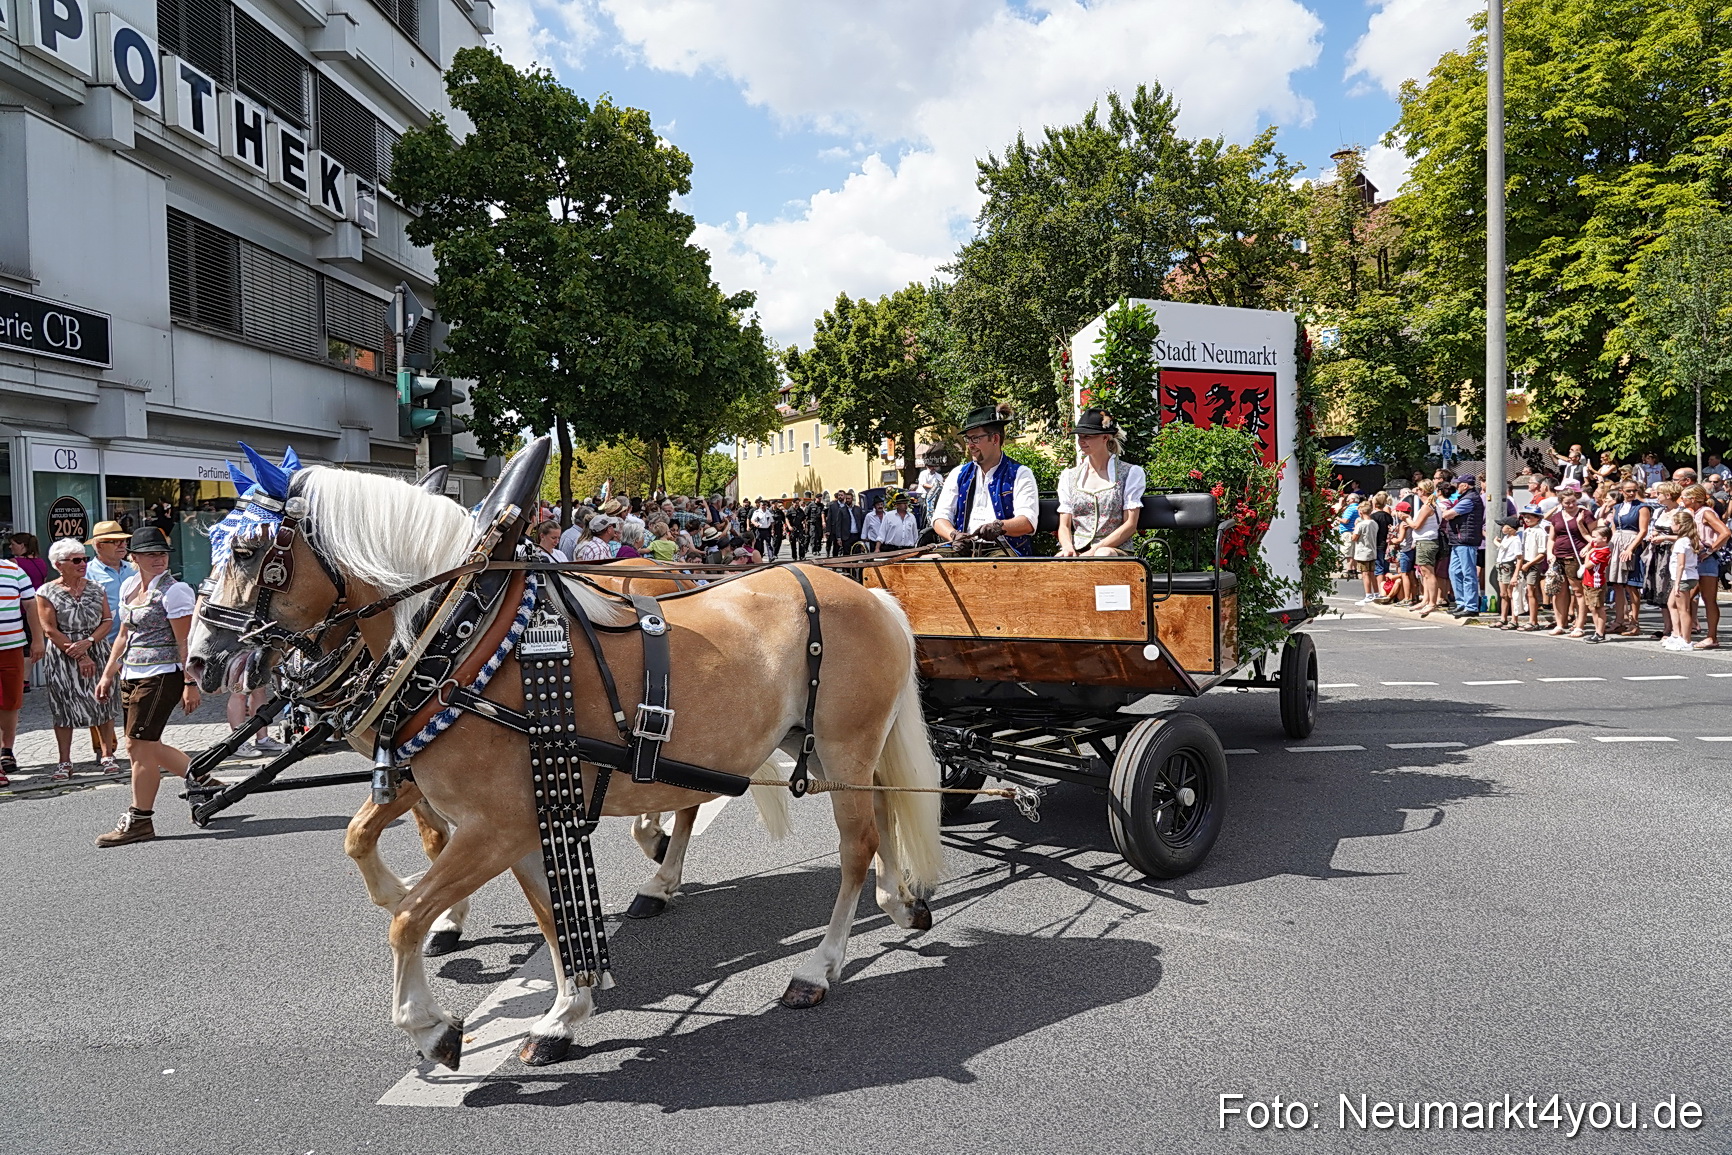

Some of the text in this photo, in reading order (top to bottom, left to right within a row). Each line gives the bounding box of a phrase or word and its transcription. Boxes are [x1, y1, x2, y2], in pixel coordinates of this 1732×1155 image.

[0, 0, 377, 234] POTHEKE
[43, 311, 82, 350] CB
[1155, 340, 1278, 366] Stadt Neumarkt
[54, 448, 78, 470] CB
[54, 519, 84, 537] 20%
